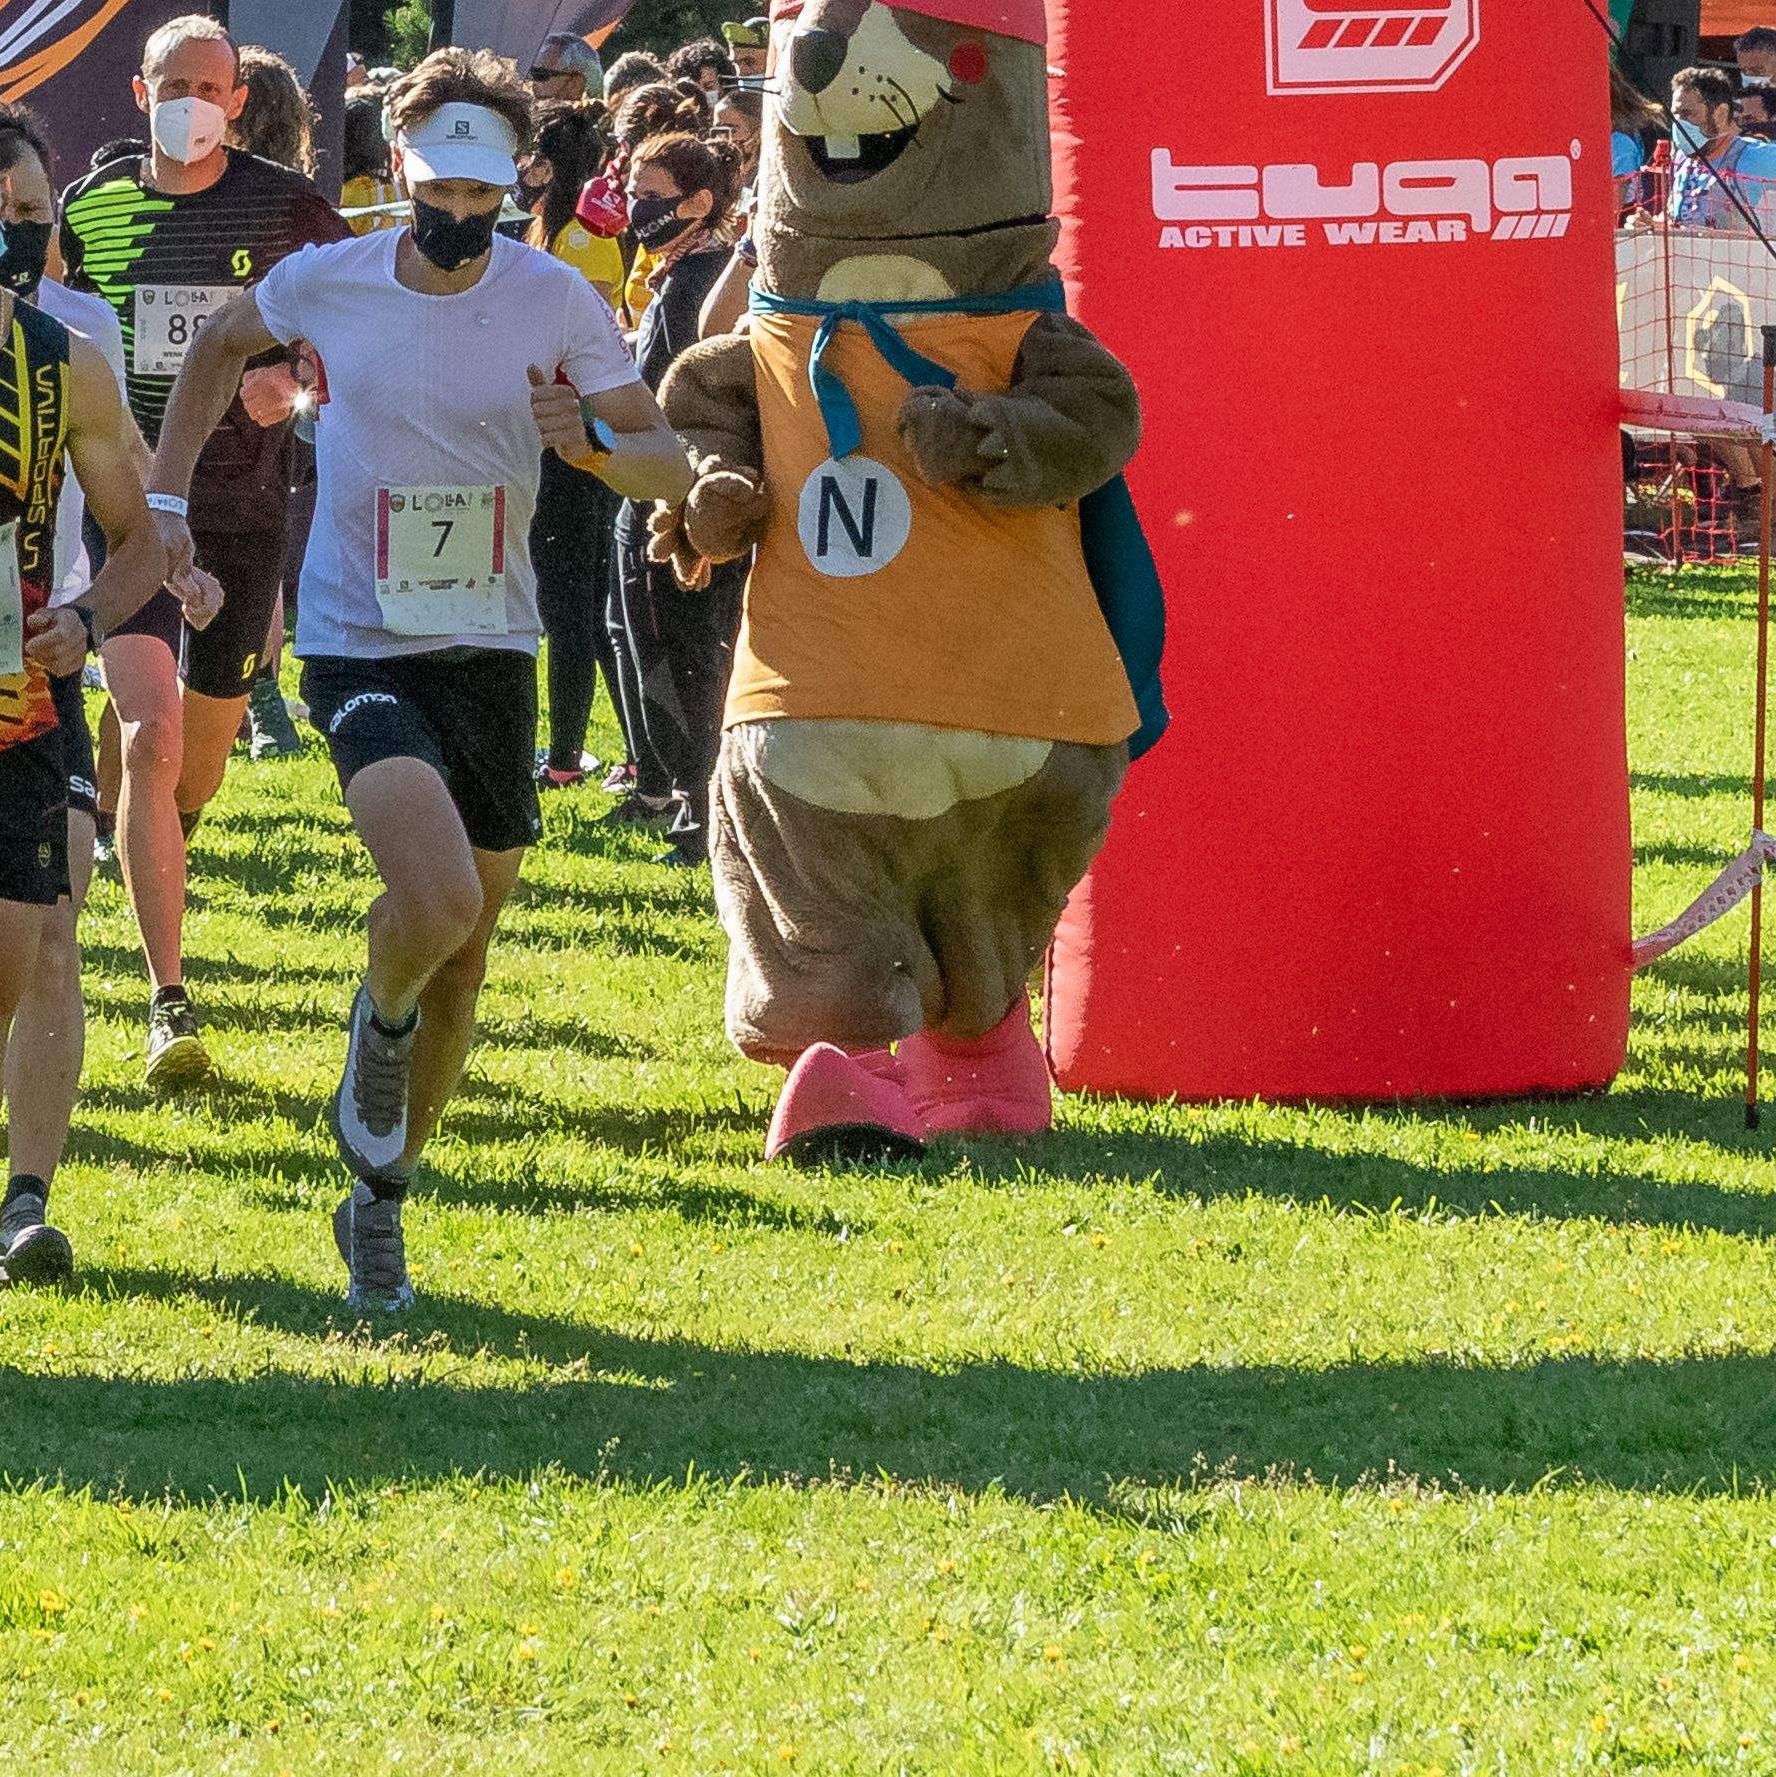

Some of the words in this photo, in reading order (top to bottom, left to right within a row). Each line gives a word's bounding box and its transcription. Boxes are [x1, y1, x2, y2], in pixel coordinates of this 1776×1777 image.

[1158, 222, 1306, 249] ACTIVE
[1322, 219, 1468, 244] WEAR
[815, 474, 878, 559] N
[431, 520, 454, 557] 7
